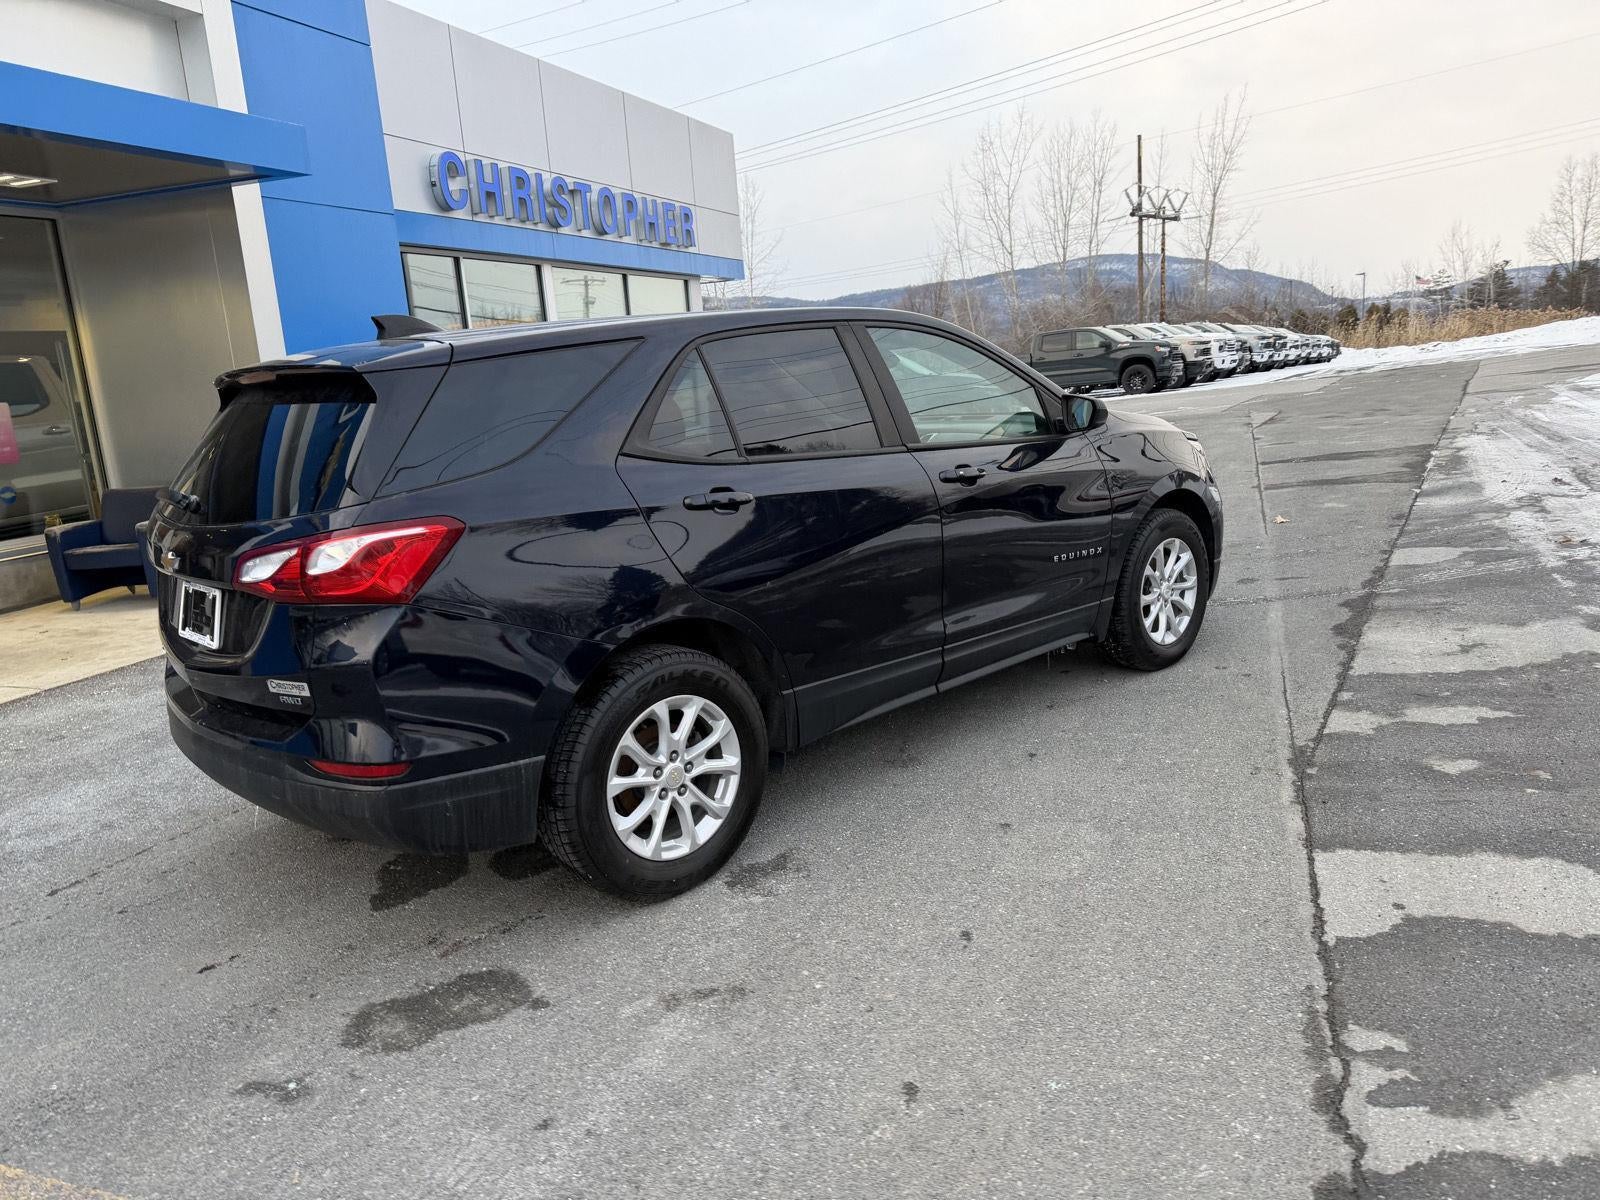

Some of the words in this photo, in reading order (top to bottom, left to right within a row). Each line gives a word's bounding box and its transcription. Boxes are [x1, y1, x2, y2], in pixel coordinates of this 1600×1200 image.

[430, 150, 697, 248] CHRISTOPHER
[1053, 546, 1103, 563] EQUINOX
[635, 668, 730, 695] FALKEN
